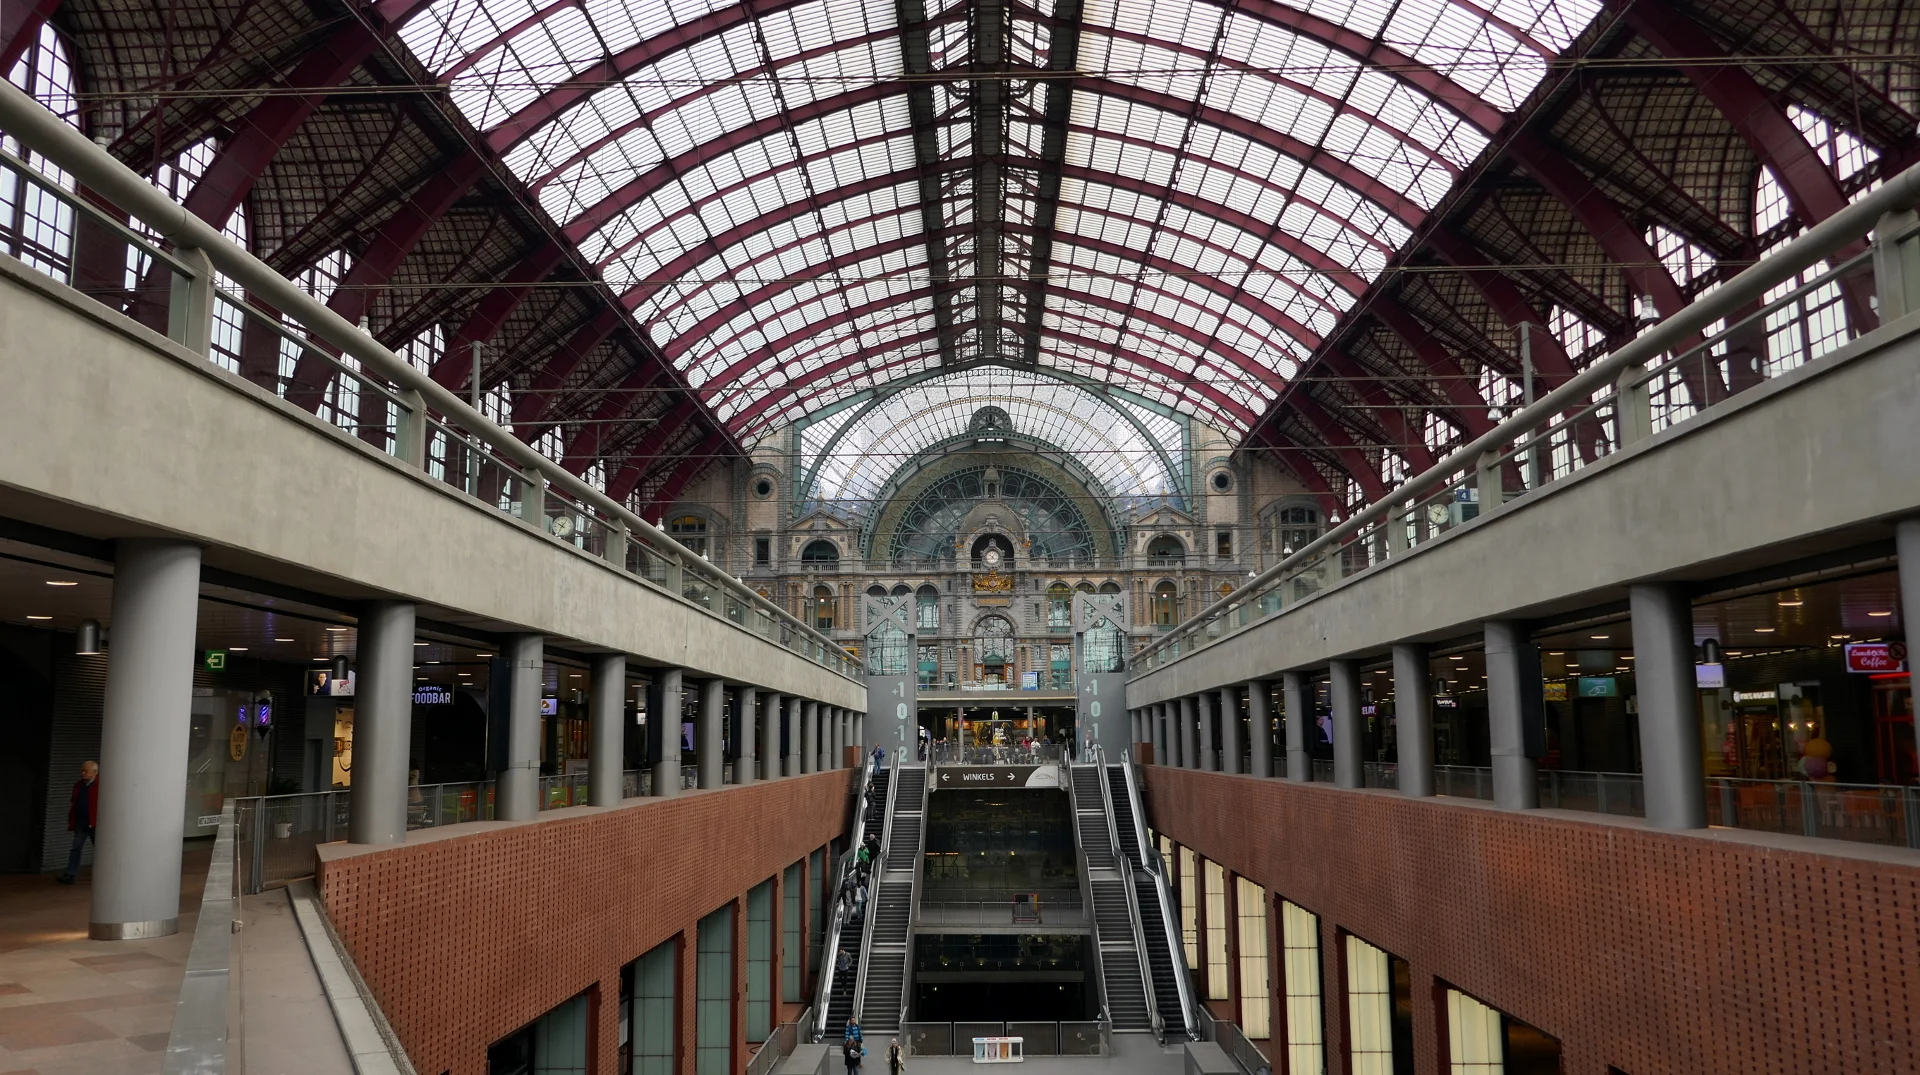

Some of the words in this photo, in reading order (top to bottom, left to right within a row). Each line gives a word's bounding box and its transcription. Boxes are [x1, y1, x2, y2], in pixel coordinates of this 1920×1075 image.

[1461, 492, 1467, 500] 4
[1861, 657, 1887, 667] Coffee
[896, 703, 908, 720] 0
[1090, 700, 1101, 718] 0
[963, 773, 995, 781] WINKELS
